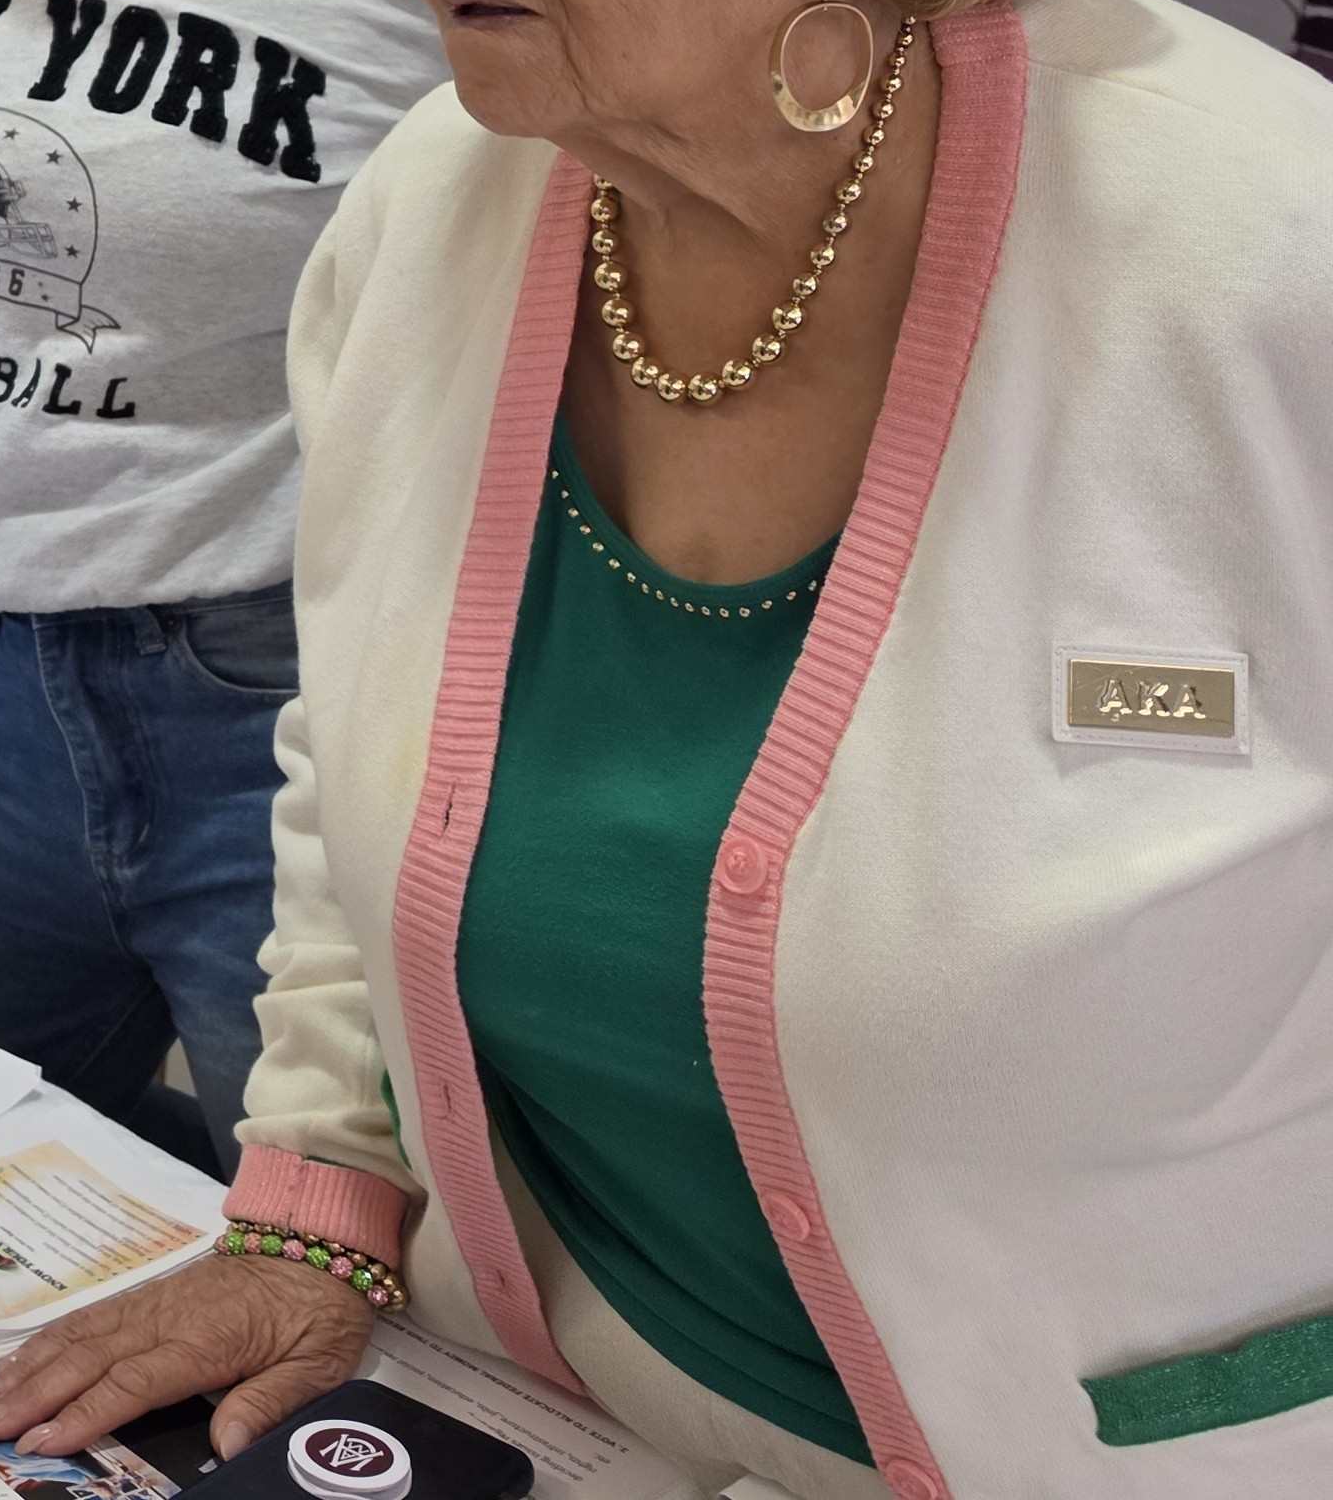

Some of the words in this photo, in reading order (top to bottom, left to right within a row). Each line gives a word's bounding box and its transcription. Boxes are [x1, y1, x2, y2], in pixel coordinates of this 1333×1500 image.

[1097, 677, 1207, 720] AKA
[3, 1247, 35, 1270] YOUR
[34, 1267, 69, 1291] KNOW
[523, 1394, 574, 1422] ALLOCATE
[573, 1421, 588, 1432] TO
[588, 1431, 616, 1447] VOTE
